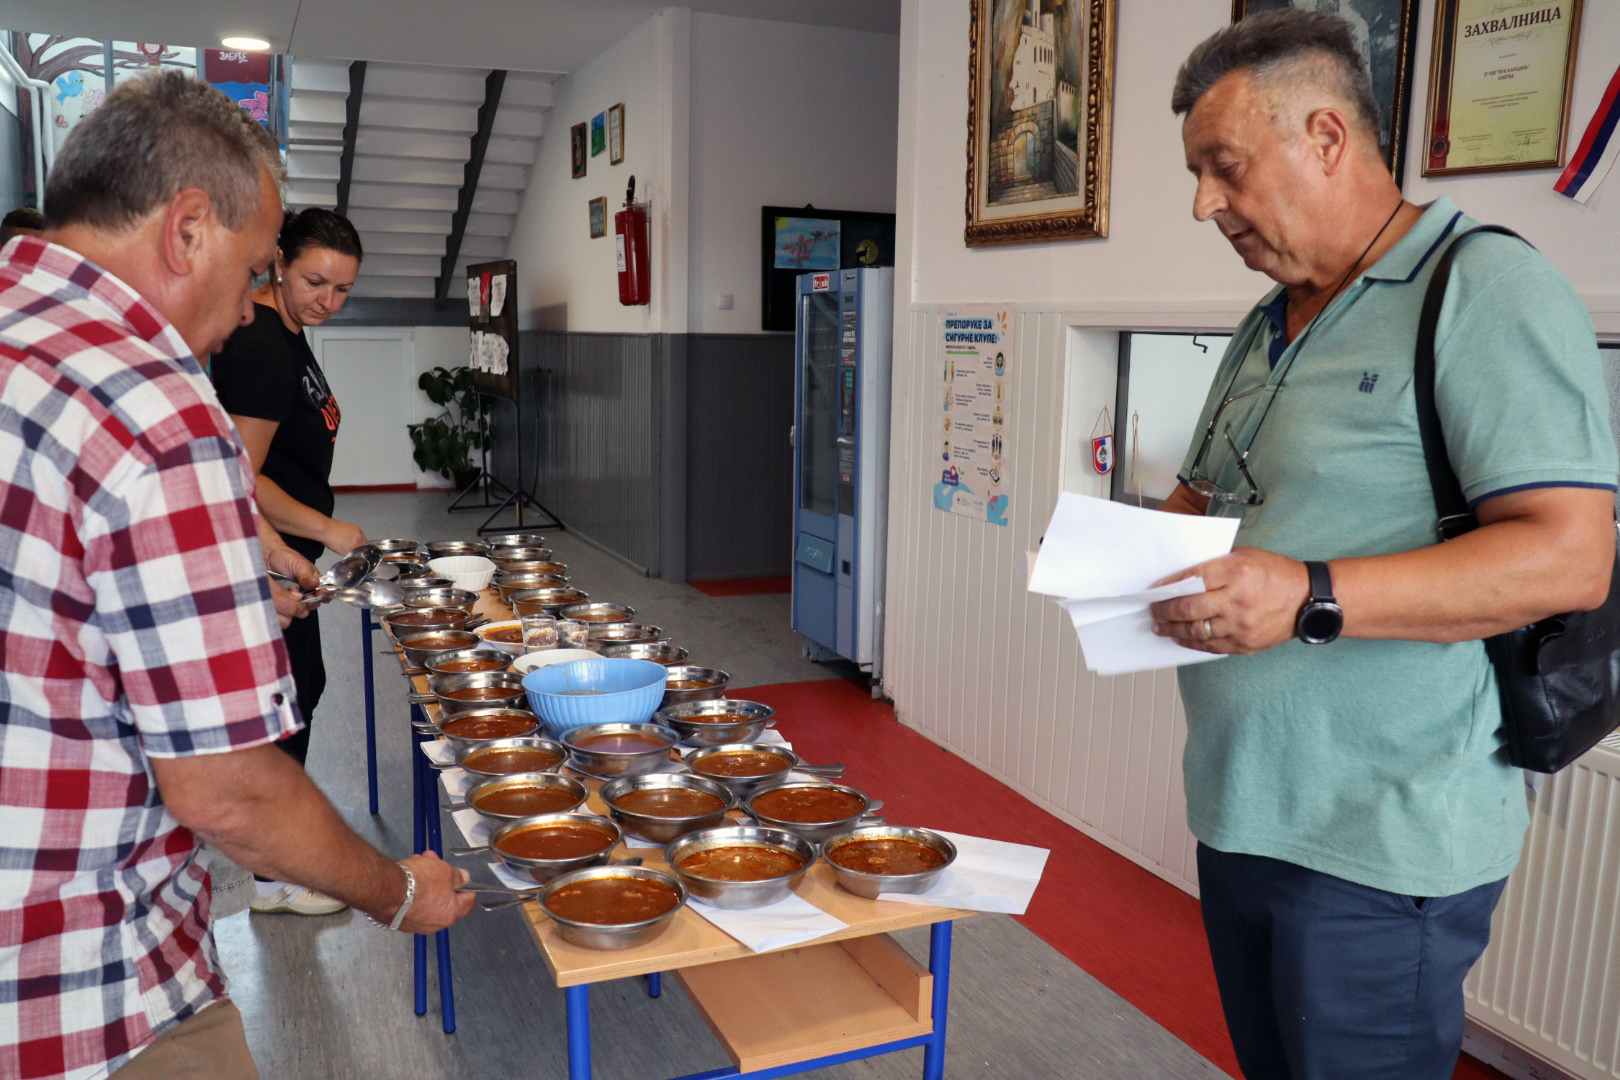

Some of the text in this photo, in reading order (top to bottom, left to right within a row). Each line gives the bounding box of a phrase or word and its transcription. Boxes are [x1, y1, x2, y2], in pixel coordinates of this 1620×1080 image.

[1464, 7, 1561, 38] ЗАХВАЛНИЦА
[945, 319, 992, 329] ПРЕПОРУКЕ ЗА
[945, 333, 997, 343] СИГУРНЕ КЛУПЕ:
